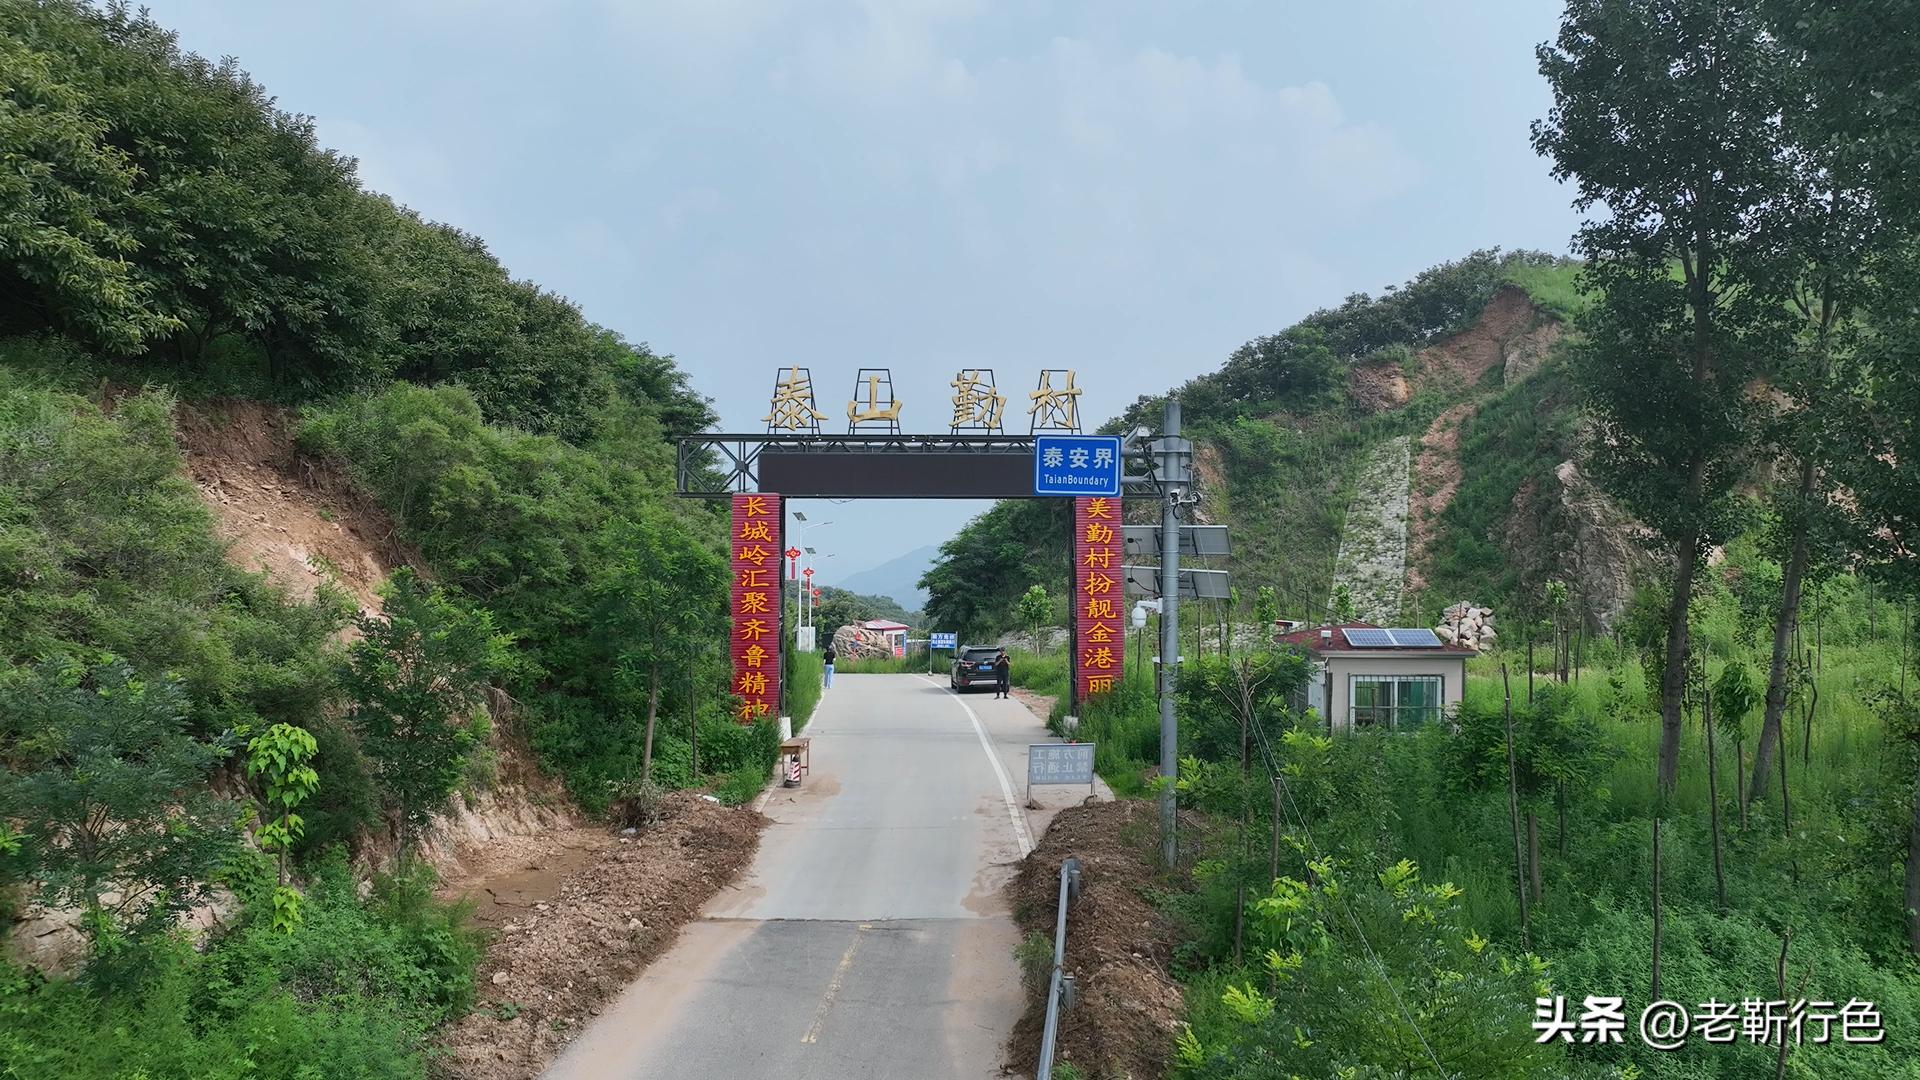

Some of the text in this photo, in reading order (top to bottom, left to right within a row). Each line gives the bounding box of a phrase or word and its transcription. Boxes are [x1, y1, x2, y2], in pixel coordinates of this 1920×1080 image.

[761, 365, 1082, 431] 泰山勤村
[1042, 446, 1115, 470] 泰安界
[1044, 474, 1109, 488] TaianBoundary
[738, 497, 771, 719] 长城岭汇聚齐鲁精神
[1084, 498, 1116, 693] 美勤村扮靓金港丽
